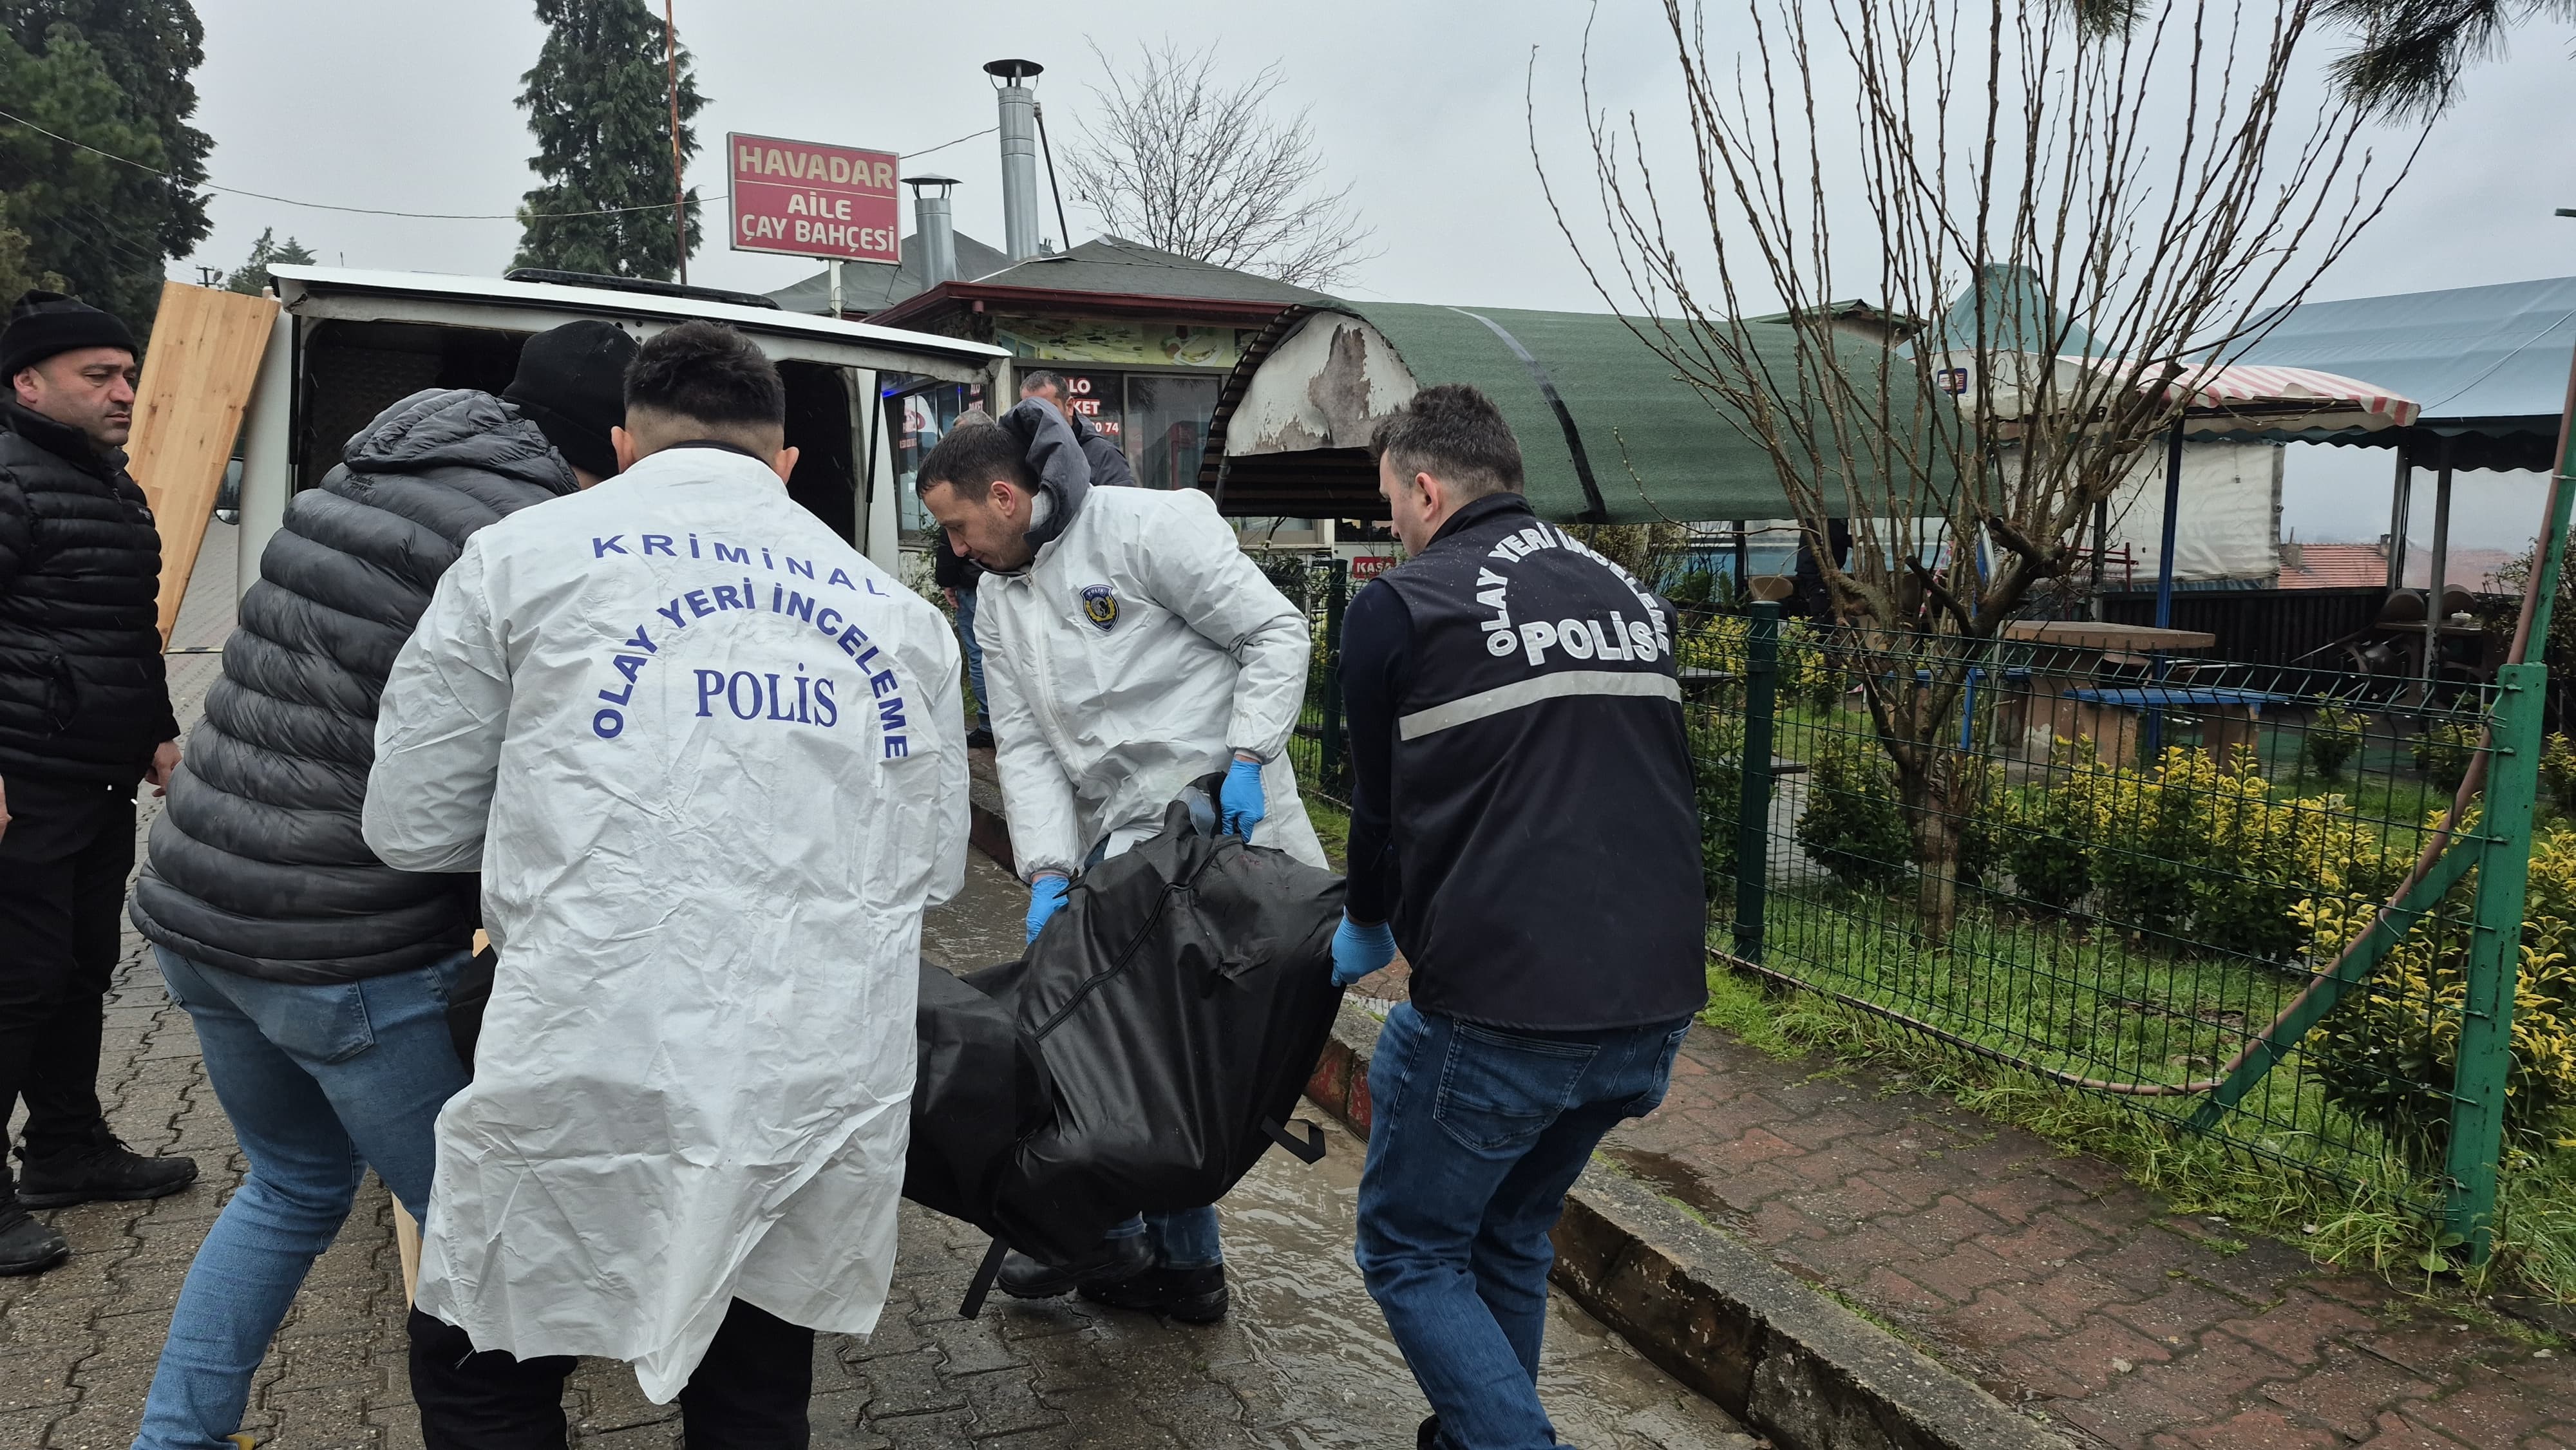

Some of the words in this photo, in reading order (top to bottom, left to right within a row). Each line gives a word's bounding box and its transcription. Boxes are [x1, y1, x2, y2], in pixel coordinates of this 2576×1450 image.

[739, 145, 894, 189] HAVADAR
[788, 191, 851, 220] AİLE
[741, 214, 787, 241] ÇAY
[795, 220, 894, 252] BAHÇESİ
[1068, 379, 1091, 393] LO
[1074, 400, 1100, 414] KET
[1105, 422, 1119, 433] 74
[1488, 522, 1557, 563] YERİ
[592, 533, 891, 598] KRİMİNAL
[1476, 567, 1518, 657] OLAY
[1519, 611, 1659, 666] POLİS
[592, 625, 658, 739] OLAY
[656, 577, 755, 628] YERİ
[772, 582, 908, 758] İNCELEME
[694, 663, 838, 728] POLİS
